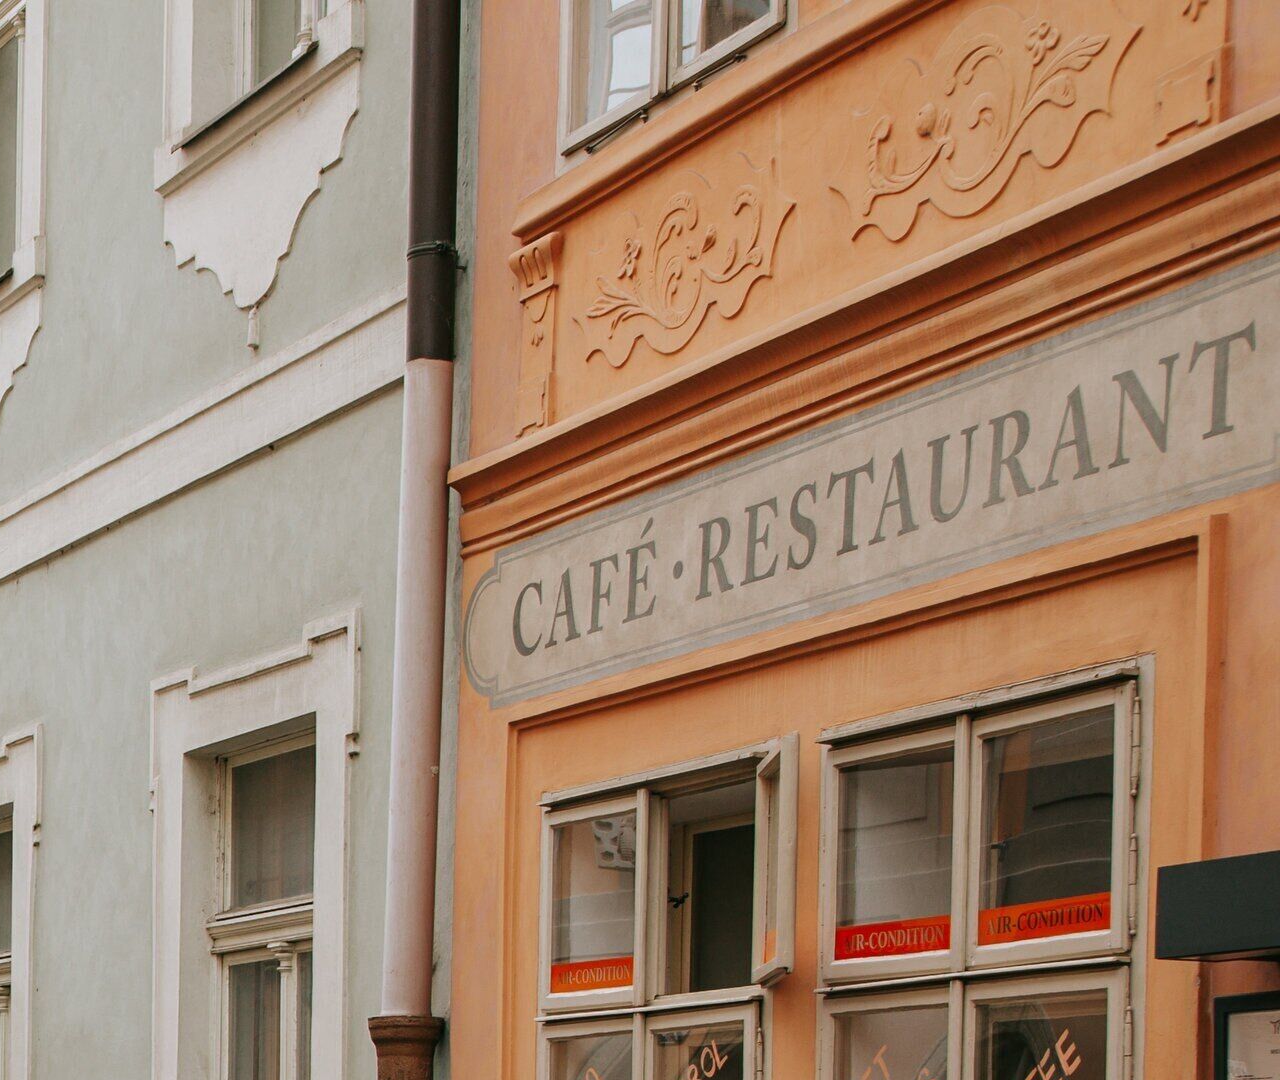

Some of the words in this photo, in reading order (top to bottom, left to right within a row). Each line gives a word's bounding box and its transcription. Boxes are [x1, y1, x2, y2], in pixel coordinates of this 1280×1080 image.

[512, 517, 657, 656] CAFÉ
[695, 321, 1256, 600] RESTAURANT
[988, 903, 1103, 936] AIR-CONDITION
[846, 925, 945, 954] AIR-CONDITION
[559, 965, 631, 985] AIR-CONDITION
